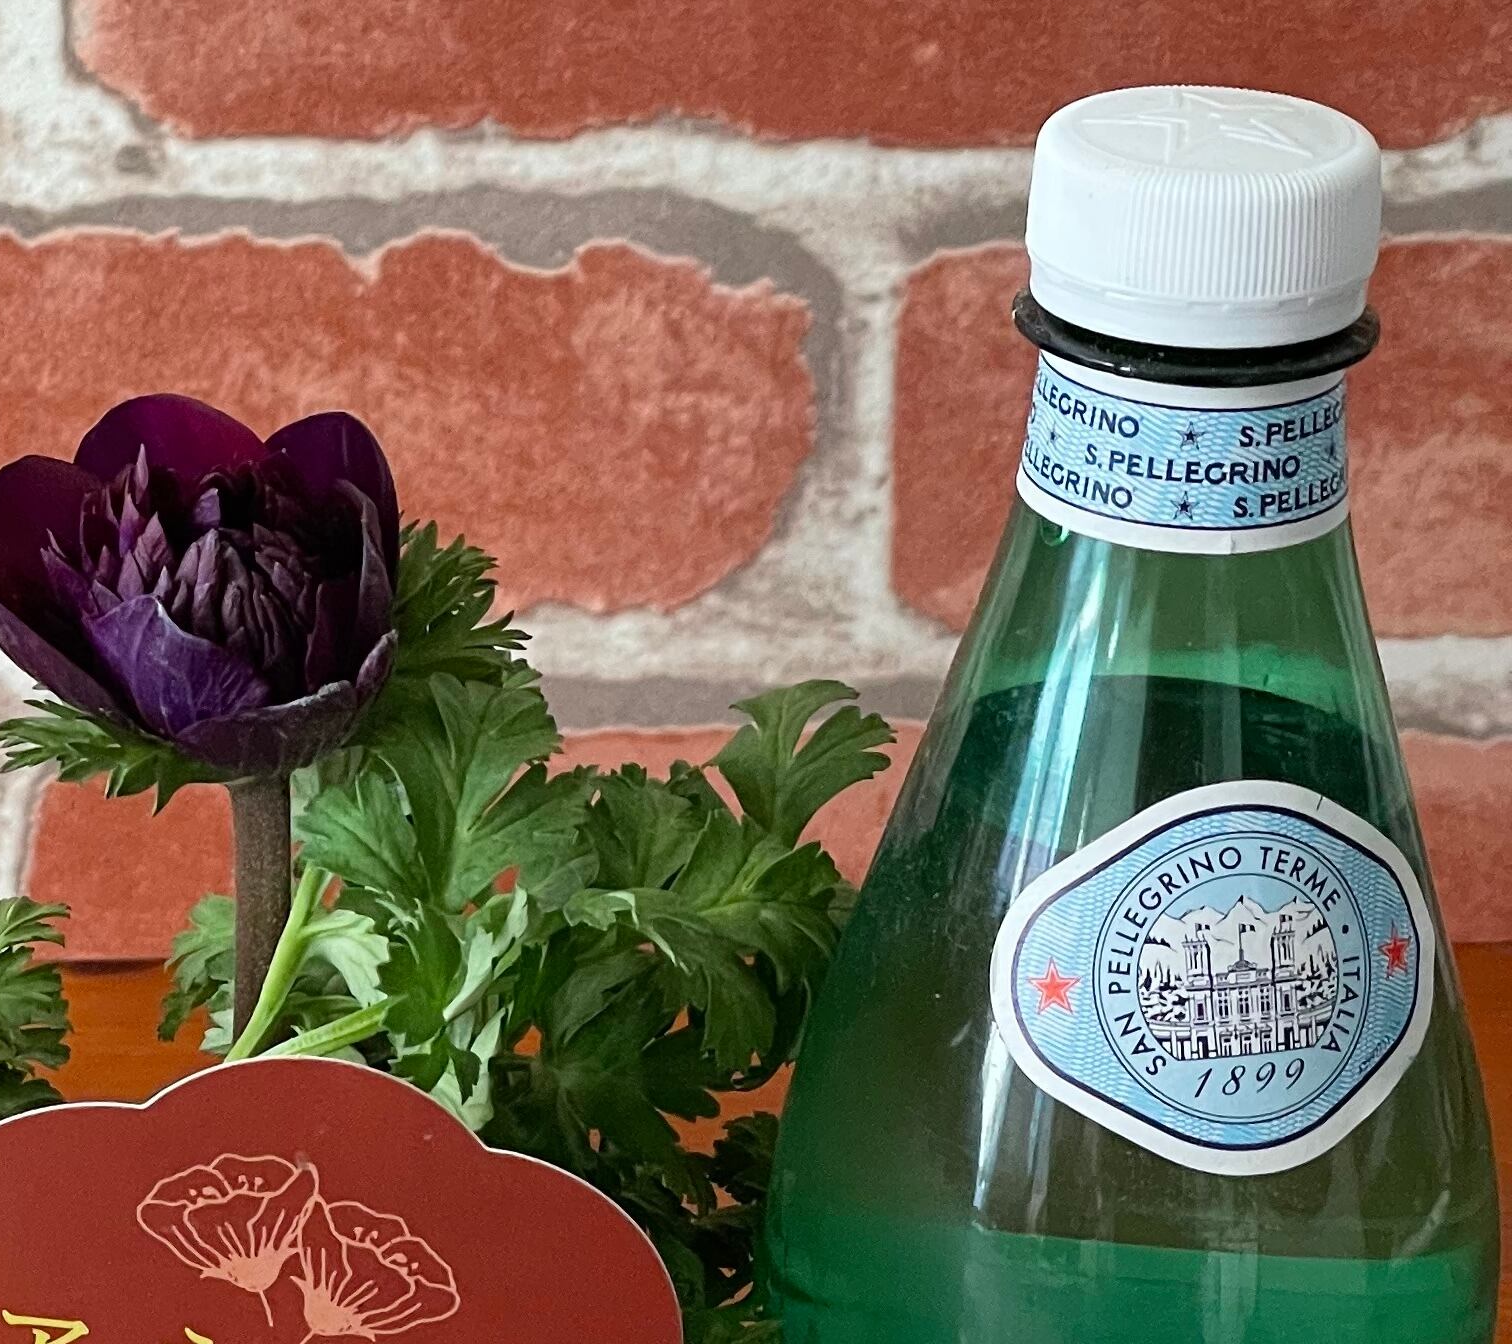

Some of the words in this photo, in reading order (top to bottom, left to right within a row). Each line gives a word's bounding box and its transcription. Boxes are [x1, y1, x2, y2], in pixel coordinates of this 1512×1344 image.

[1259, 845, 1342, 913] TERME
[1107, 845, 1242, 996] PELLEGRINO
[1319, 954, 1361, 1055] ITALIA
[1114, 1011, 1167, 1076] SAN
[1194, 1057, 1305, 1098] 1899
